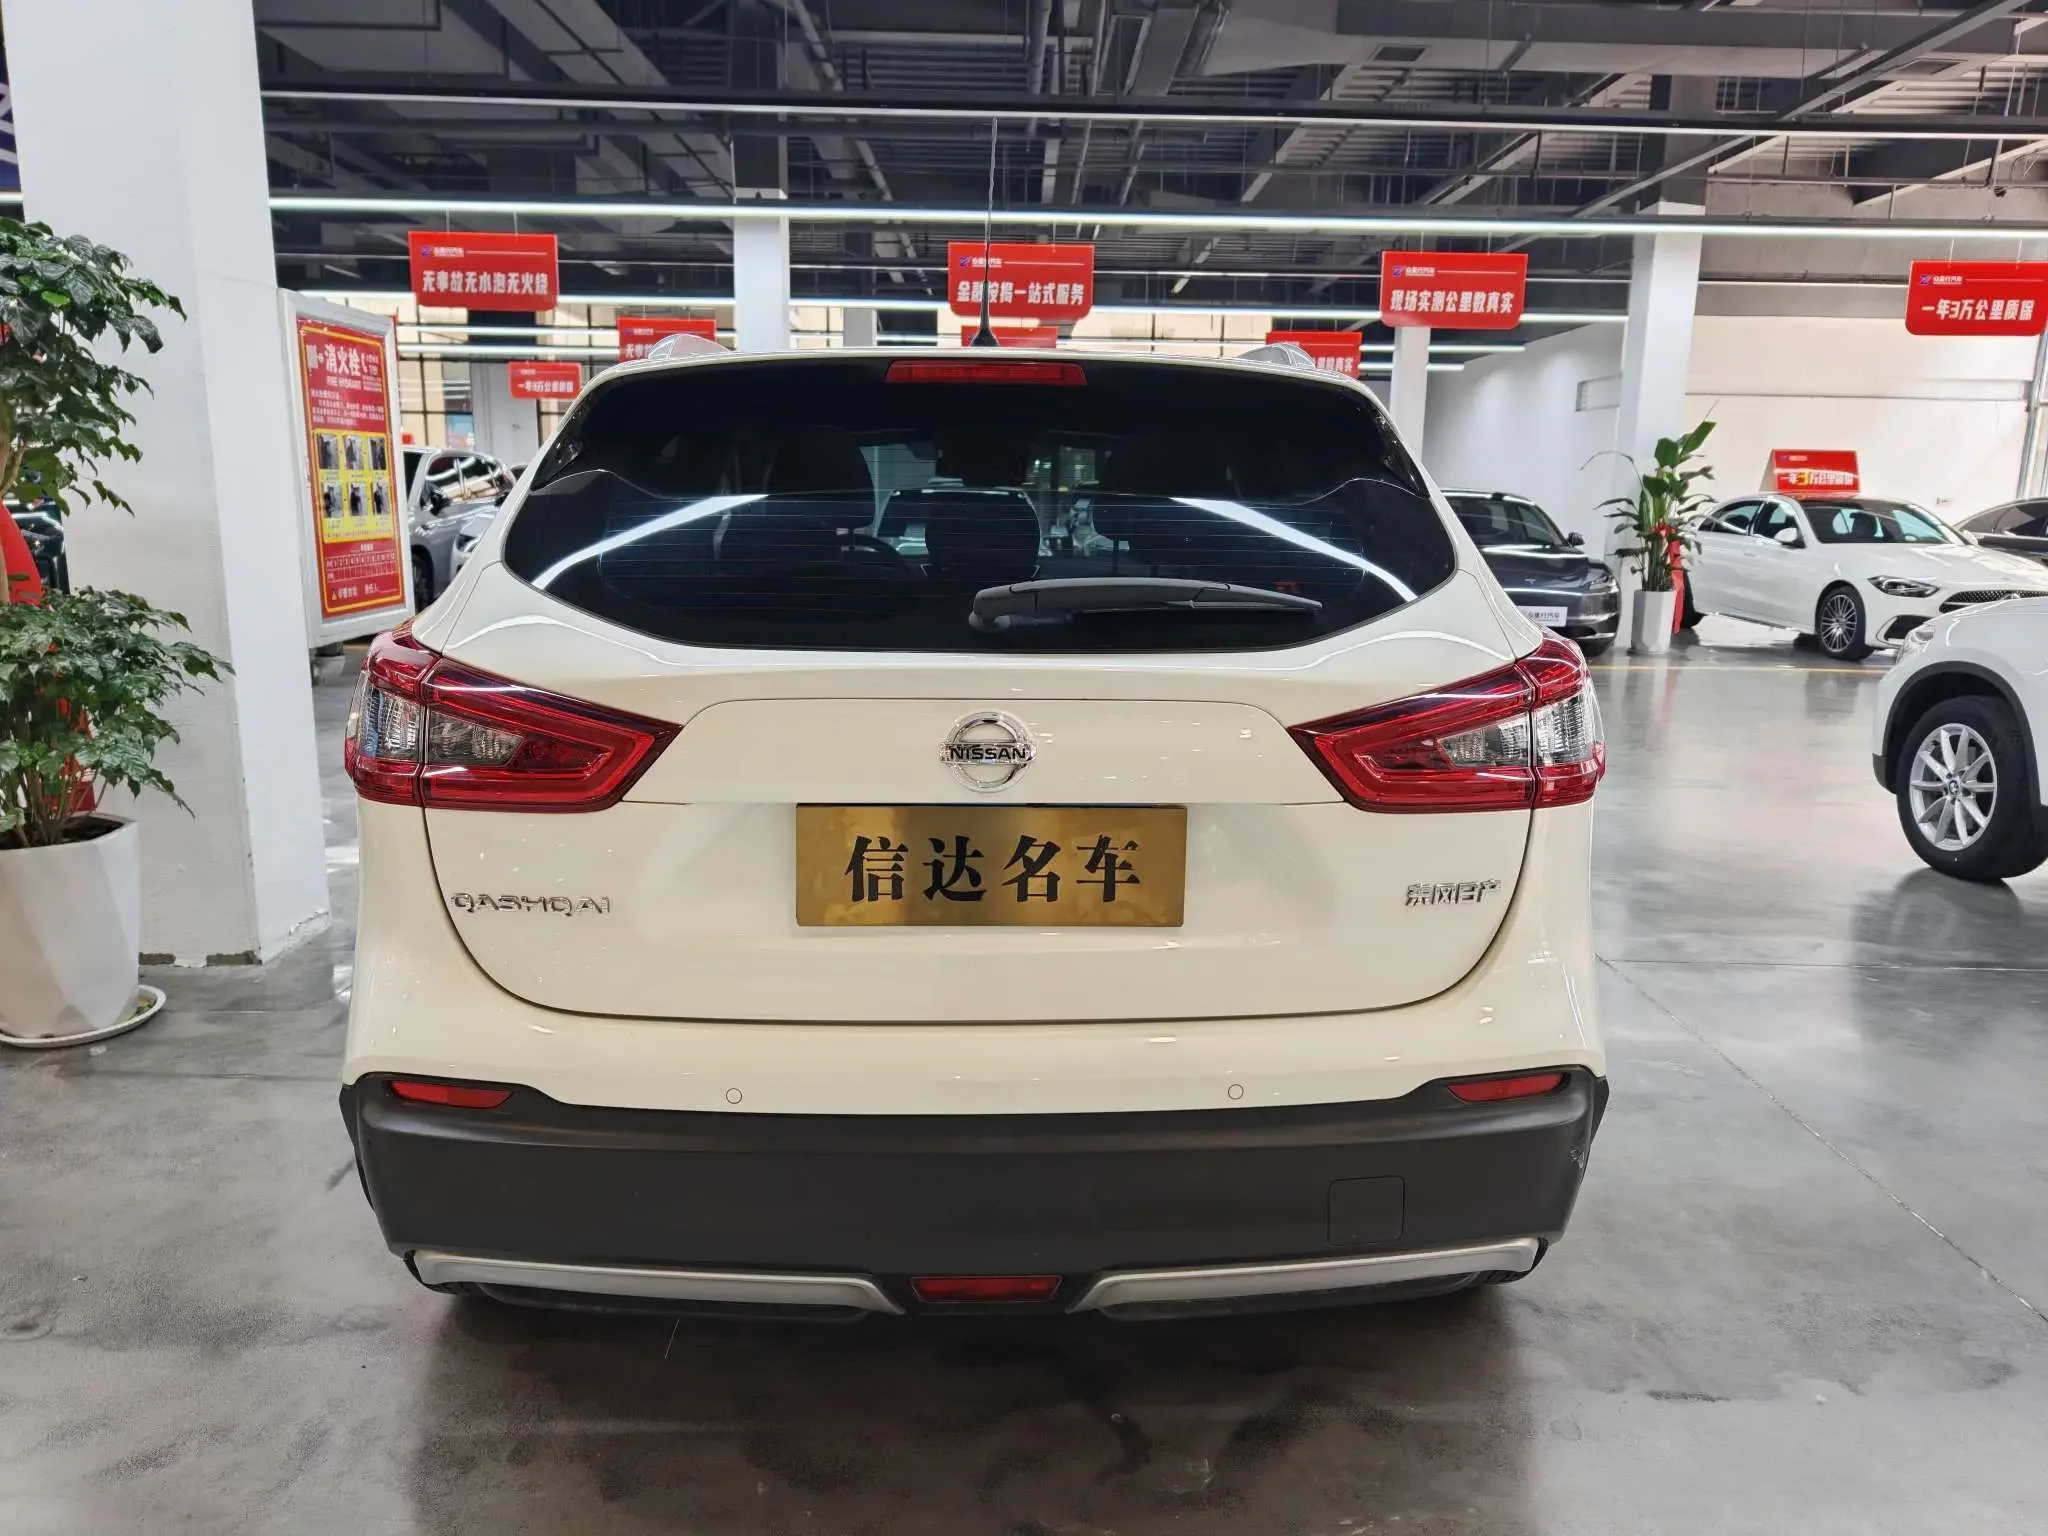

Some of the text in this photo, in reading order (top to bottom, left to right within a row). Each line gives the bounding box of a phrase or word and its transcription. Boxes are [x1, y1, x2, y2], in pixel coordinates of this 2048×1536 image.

[1390, 289, 1515, 314] 现场实测公里数真实
[1921, 298, 2035, 320] 一年3万公里质保
[949, 747, 1026, 760] NISSAN
[844, 834, 1141, 903] 信达名车
[451, 892, 612, 916] QASHQAI
[1405, 879, 1500, 906] 东风日产
